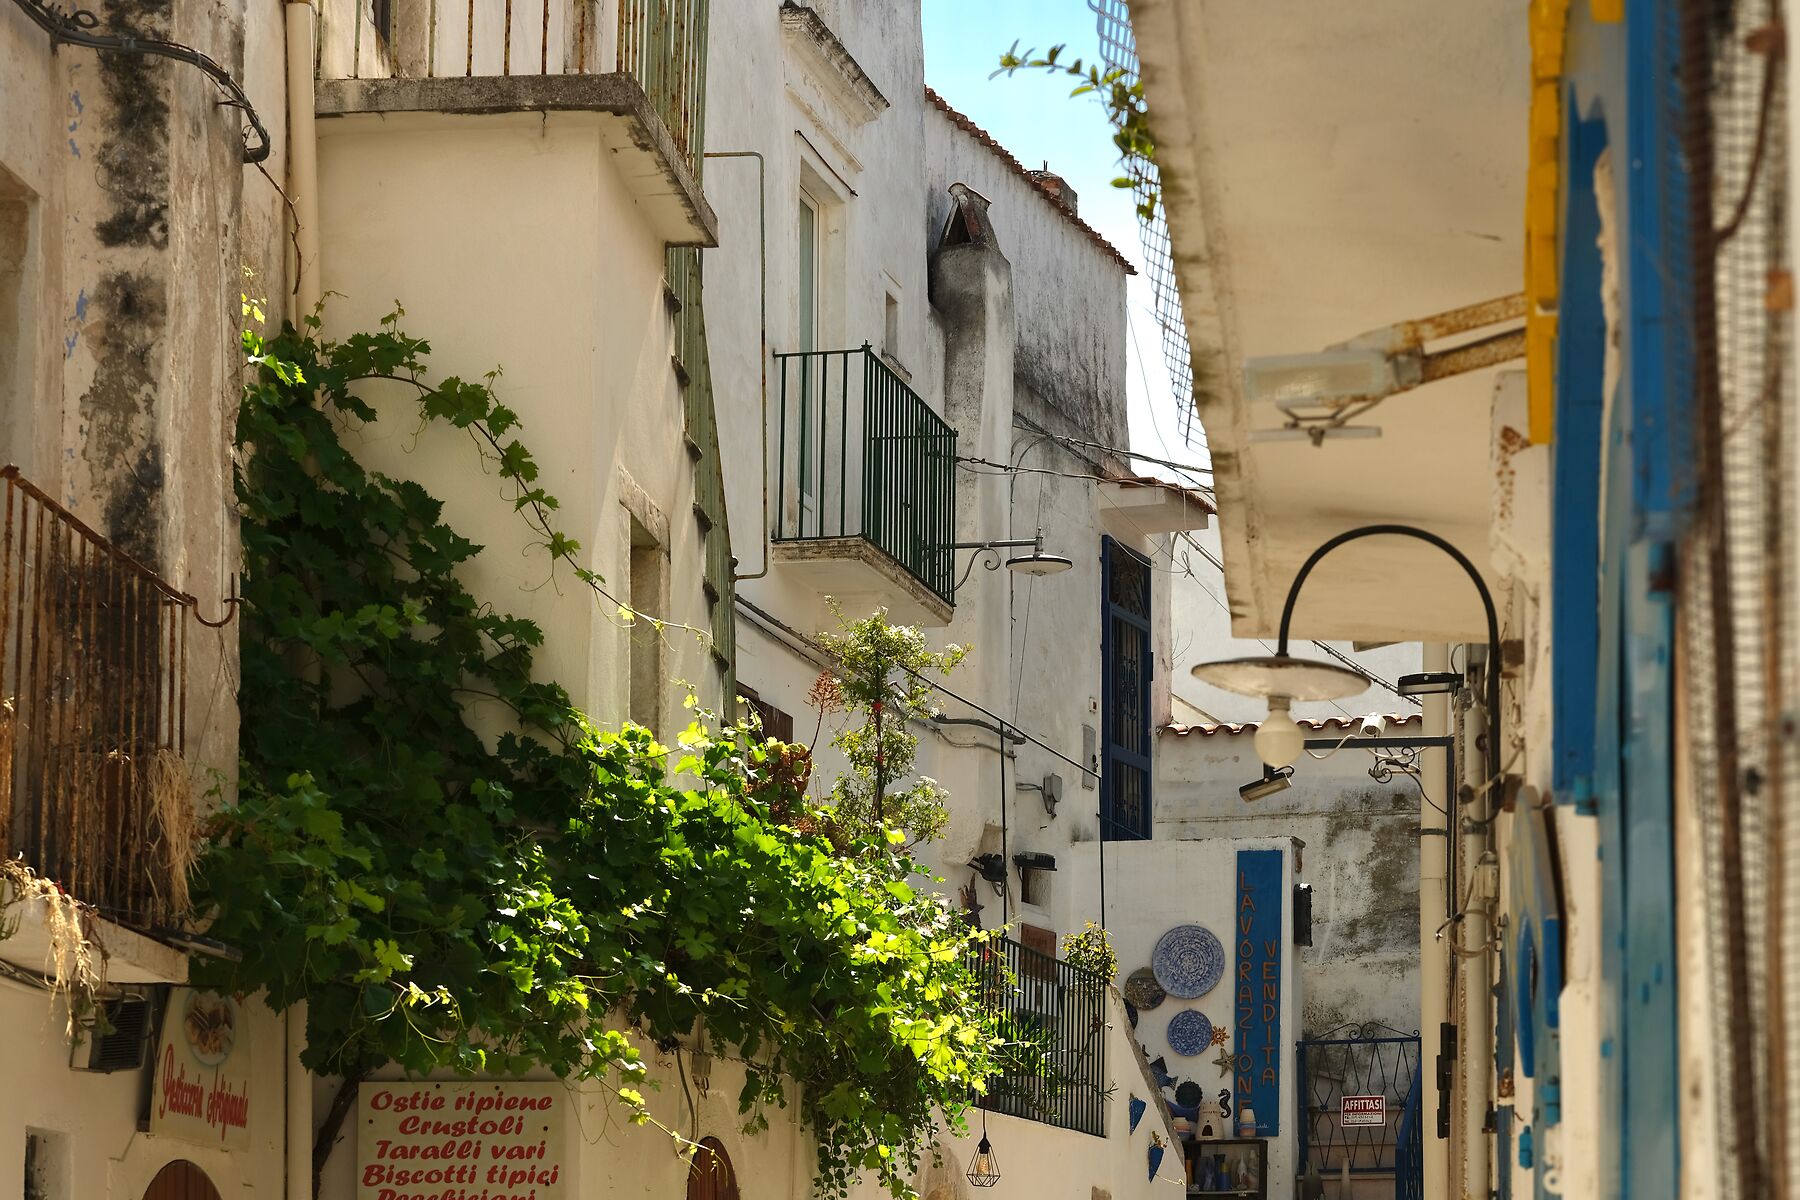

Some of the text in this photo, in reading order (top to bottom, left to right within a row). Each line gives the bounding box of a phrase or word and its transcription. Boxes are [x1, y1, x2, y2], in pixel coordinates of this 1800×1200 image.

[1262, 940, 1278, 1087] VENDITA
[371, 1090, 552, 1117] Ostie ripiene
[1344, 1100, 1382, 1110] AFFITTASI
[398, 1116, 523, 1135] Crustoli
[376, 1140, 546, 1160] Taralli vari
[362, 1165, 559, 1189] Biscotti tipici
